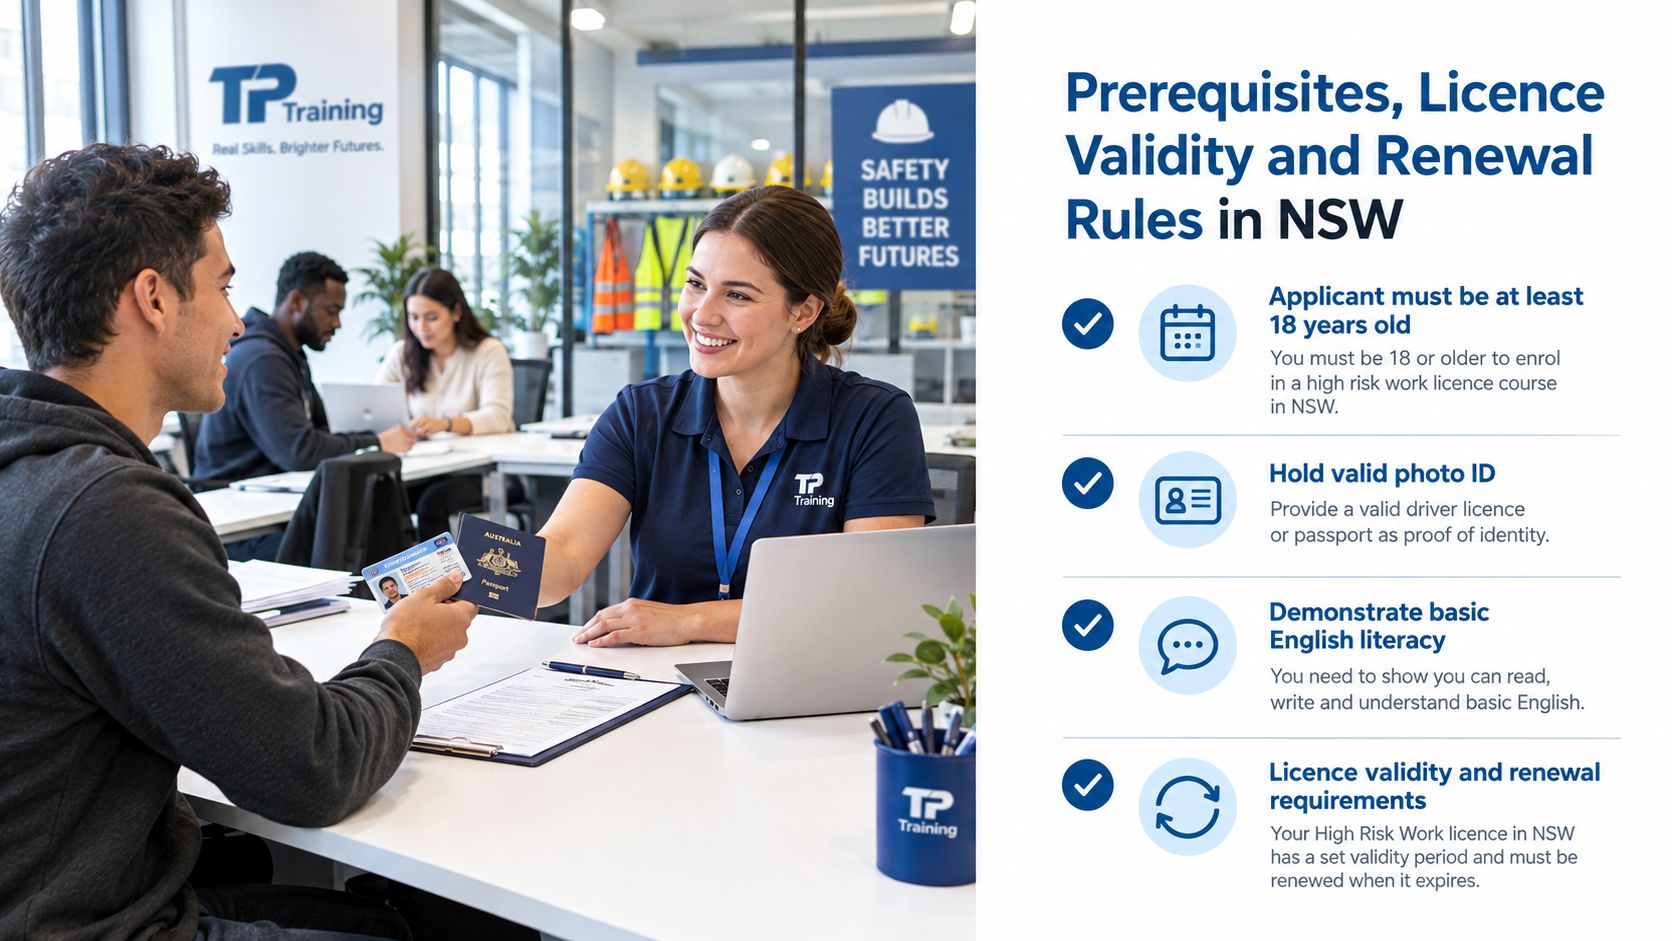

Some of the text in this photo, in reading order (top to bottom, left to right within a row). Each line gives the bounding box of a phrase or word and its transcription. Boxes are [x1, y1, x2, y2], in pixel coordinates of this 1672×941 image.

[209, 63, 384, 126] TP Training
[212, 140, 385, 157] Real Skills. Brighter Futures.
[861, 158, 950, 181] SAFETY
[863, 188, 949, 210] BUILDS
[862, 217, 950, 238] BETTER
[859, 245, 959, 267] FUTURES
[794, 472, 824, 495] TP
[794, 495, 835, 508] Training
[901, 786, 955, 820] TP
[898, 818, 958, 839] Training
